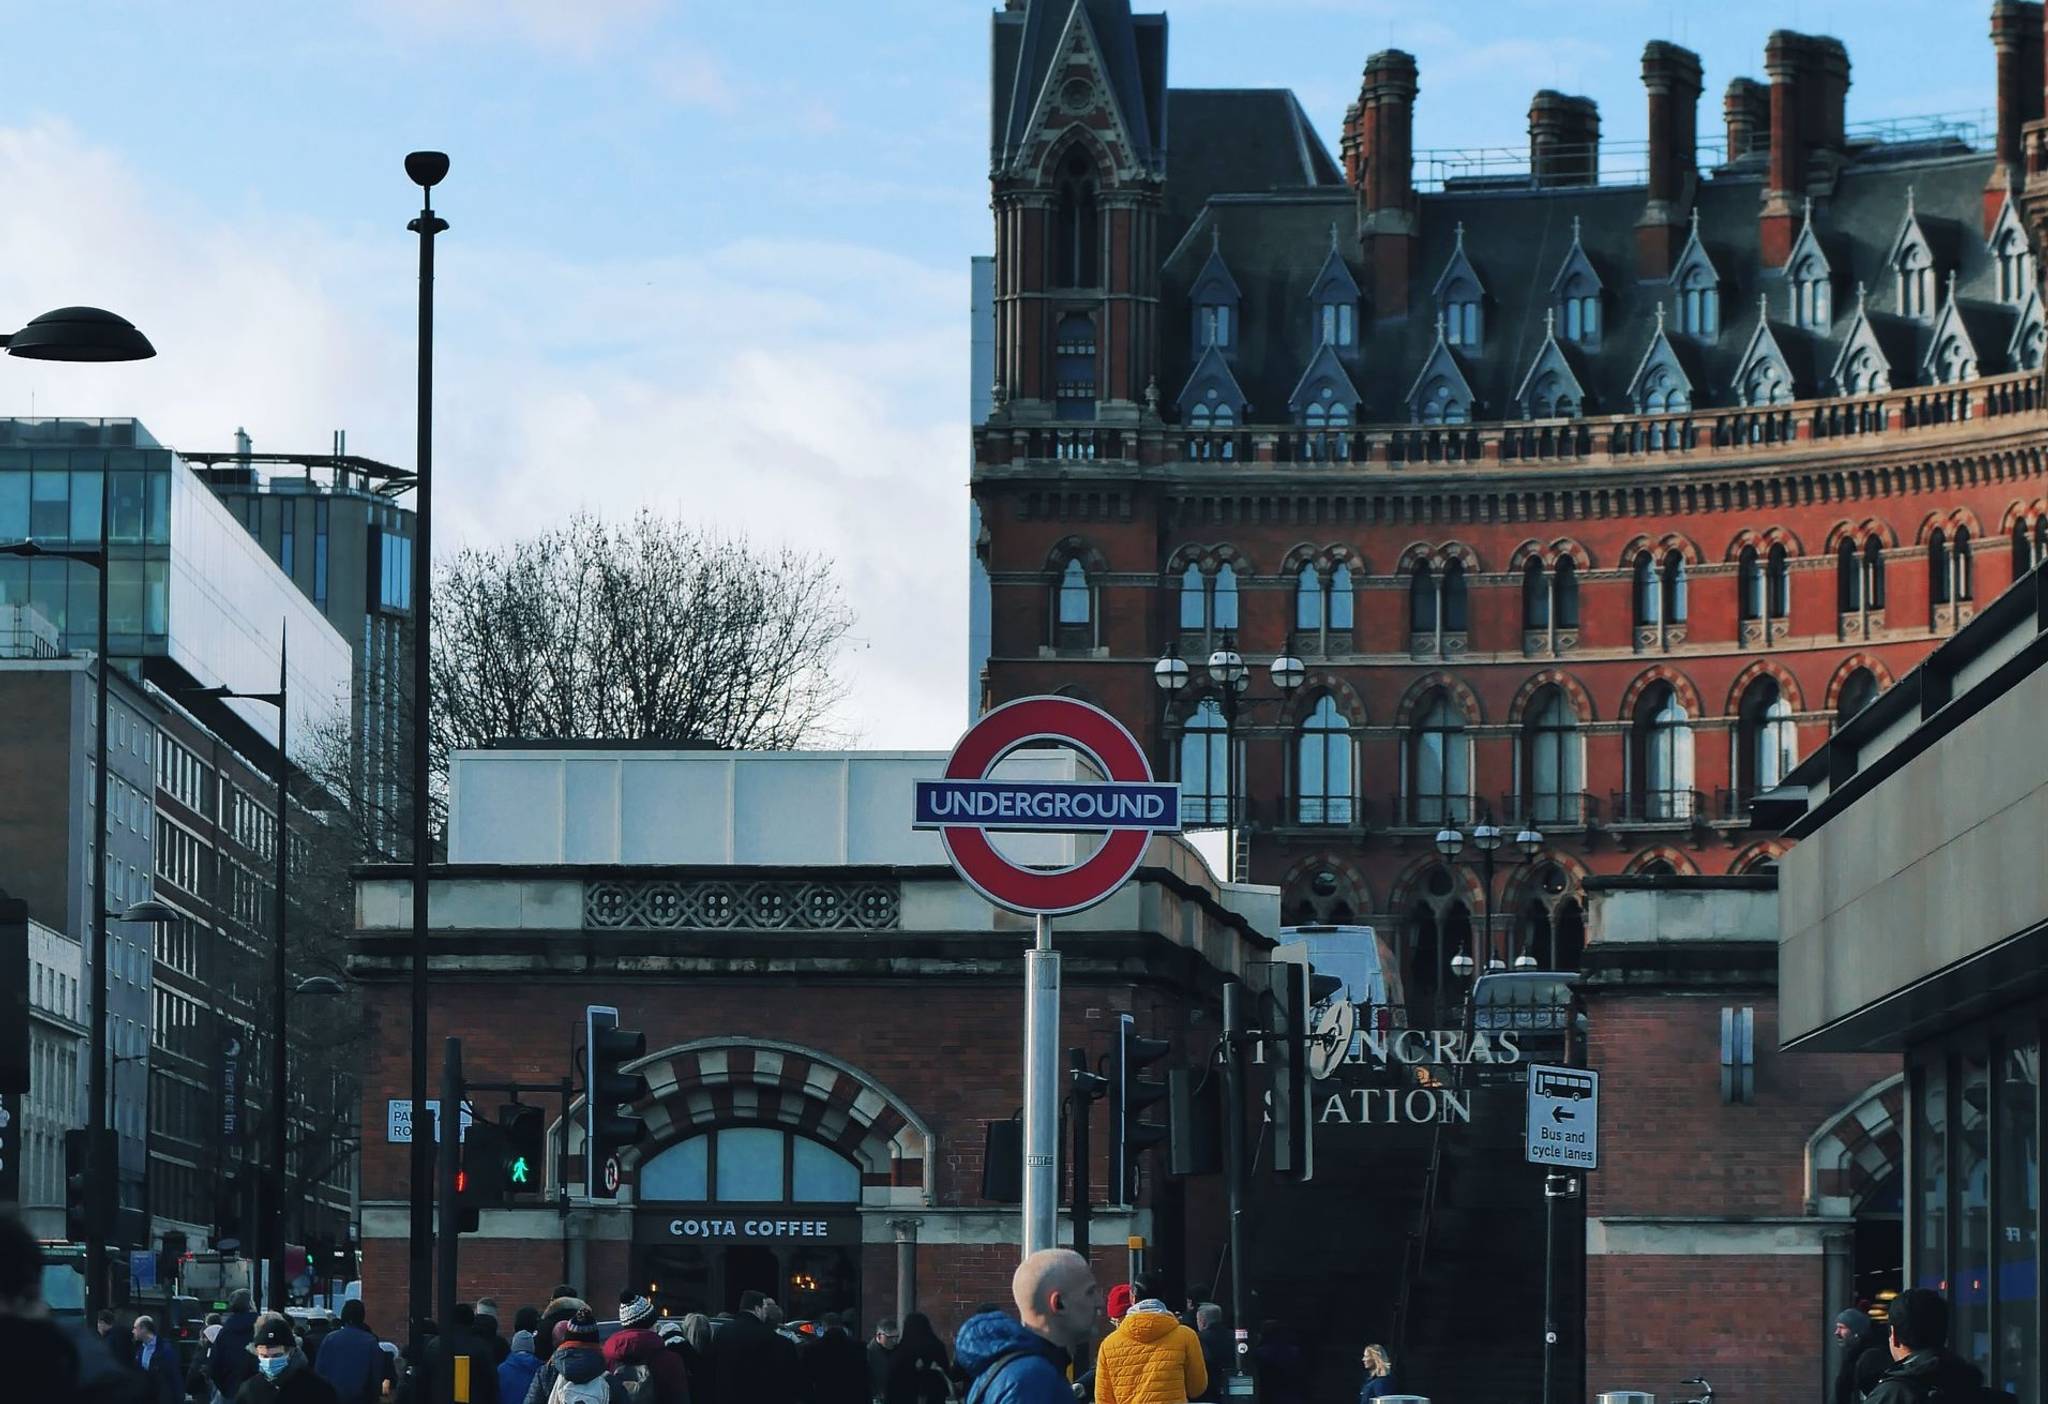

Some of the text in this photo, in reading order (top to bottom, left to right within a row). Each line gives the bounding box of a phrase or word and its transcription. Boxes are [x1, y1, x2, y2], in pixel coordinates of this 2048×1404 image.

[930, 790, 1165, 819] UNDERGROUND
[1343, 1028, 1521, 1065] NCRAS
[1541, 1126, 1585, 1144] Bus and
[1531, 1144, 1593, 1161] cycle lanes
[669, 1219, 828, 1238] COSTA COFFEE
